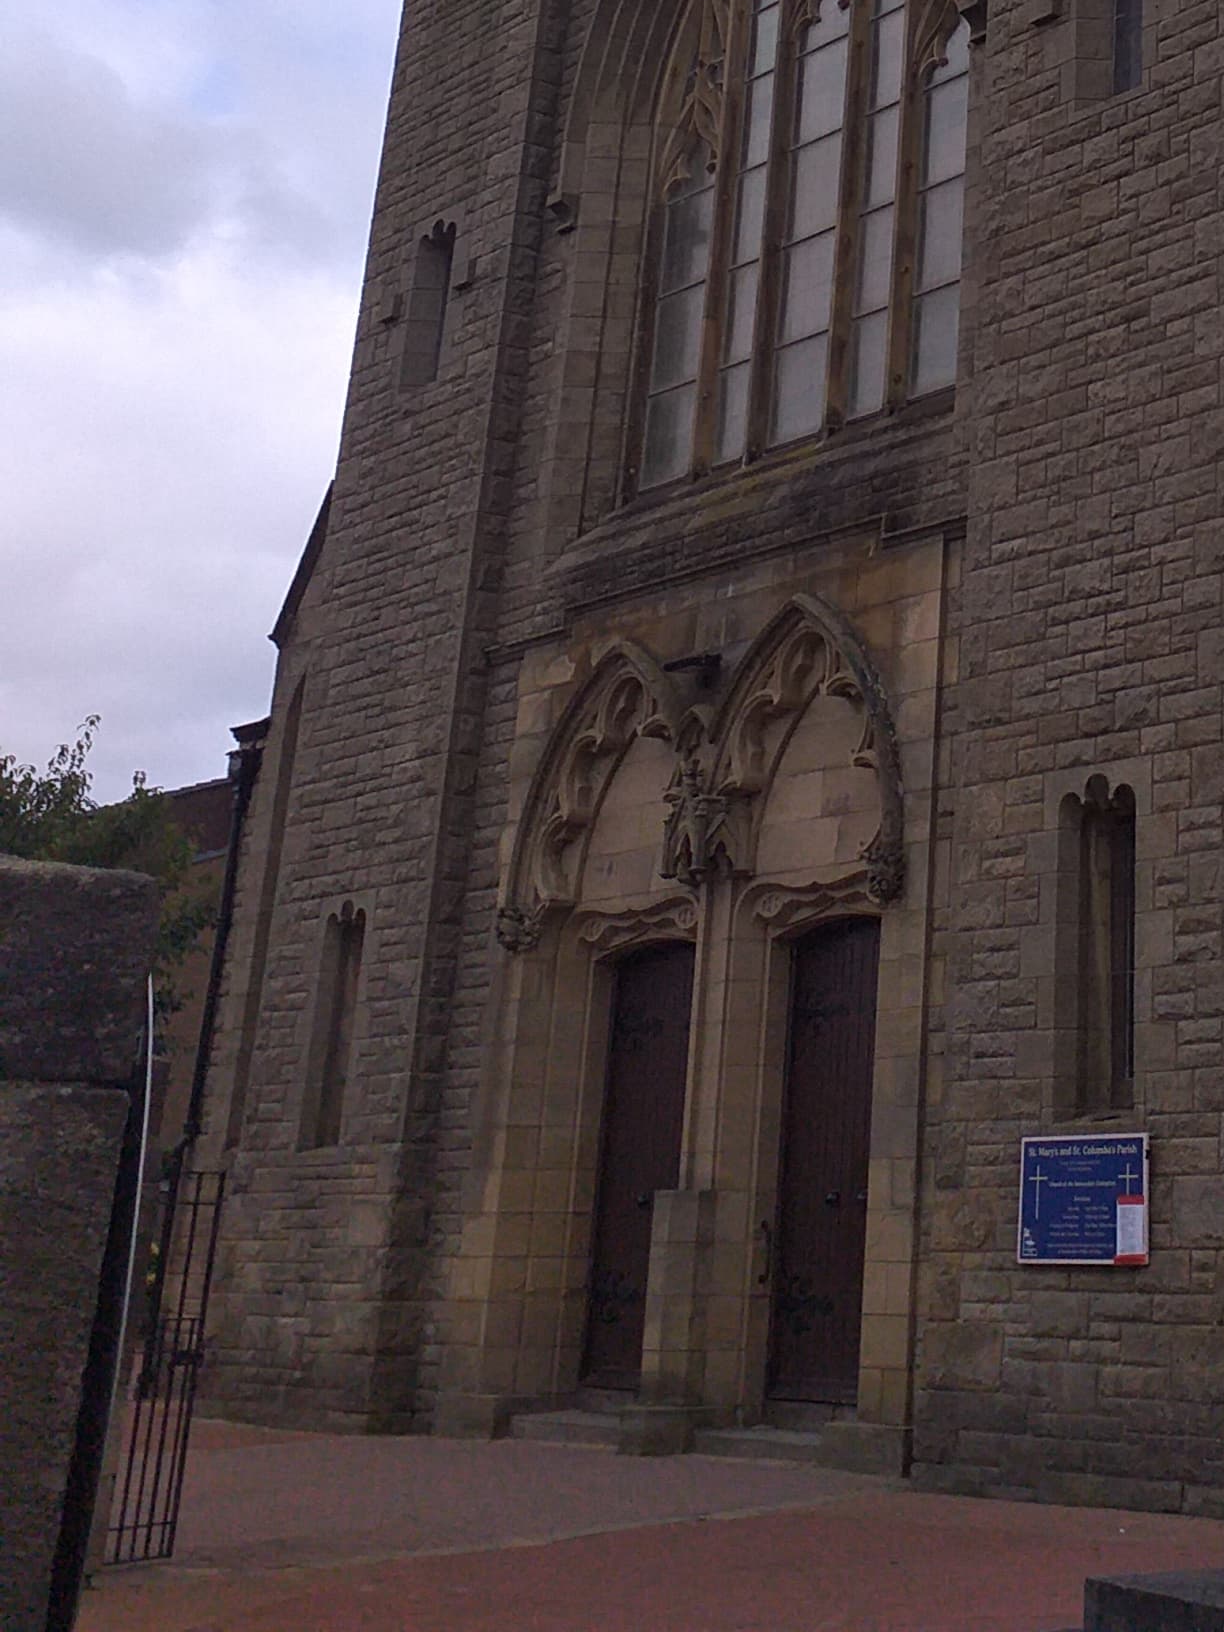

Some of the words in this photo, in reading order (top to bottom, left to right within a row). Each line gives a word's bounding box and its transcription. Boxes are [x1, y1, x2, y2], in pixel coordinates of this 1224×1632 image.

[1038, 1146, 1058, 1158] Mary's
[1060, 1145, 1073, 1155] and
[1083, 1144, 1116, 1155] Columba's
[1117, 1143, 1138, 1154] Parish
